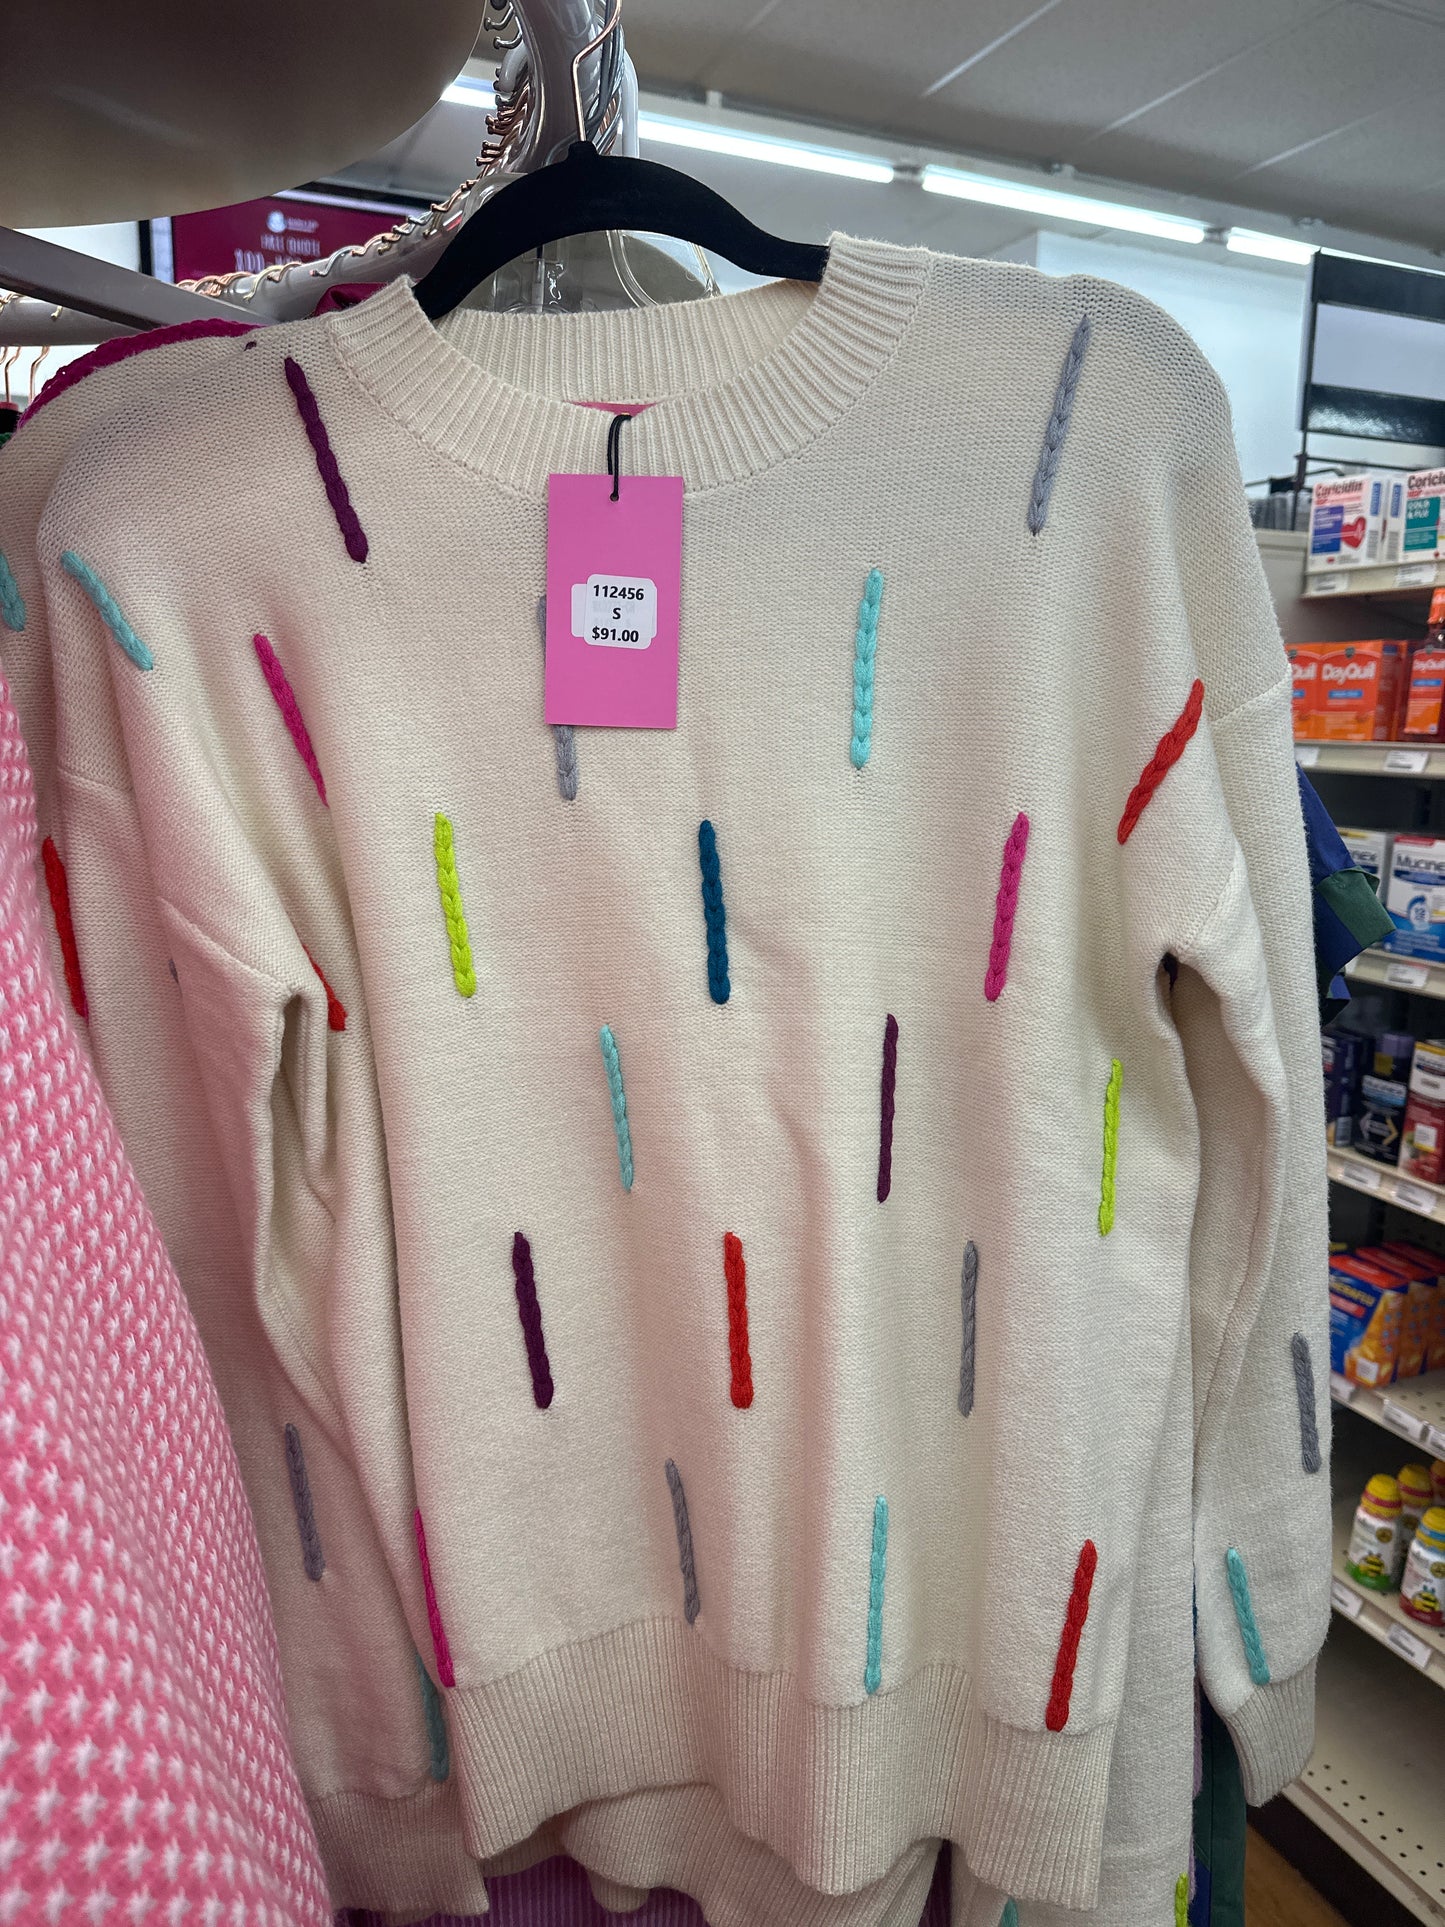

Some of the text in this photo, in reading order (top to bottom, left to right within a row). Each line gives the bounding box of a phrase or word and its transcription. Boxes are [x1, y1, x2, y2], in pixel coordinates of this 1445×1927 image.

[1315, 480, 1363, 499] Coricidin
[593, 584, 645, 601] 112456
[612, 607, 622, 620] S
[592, 626, 639, 643] $91.00
[1321, 661, 1377, 686] DayQuil
